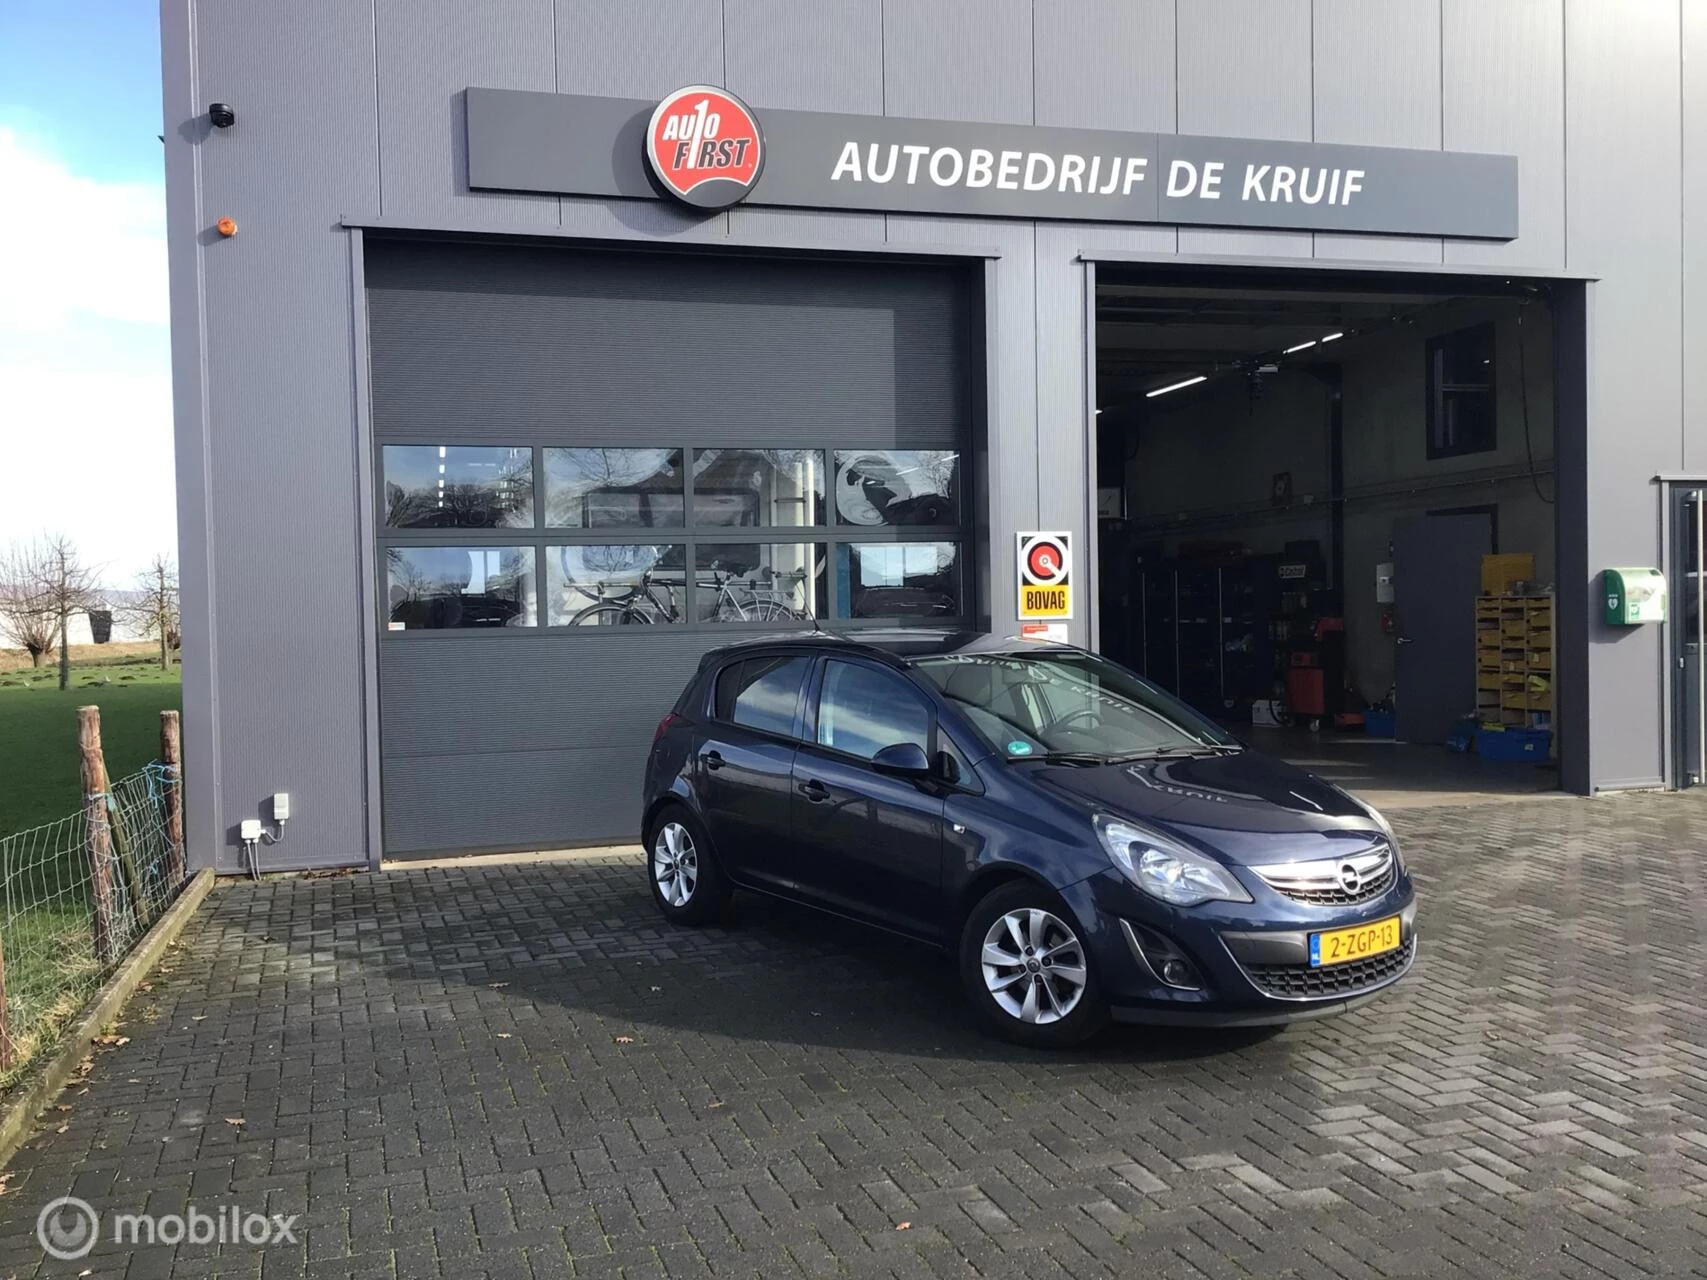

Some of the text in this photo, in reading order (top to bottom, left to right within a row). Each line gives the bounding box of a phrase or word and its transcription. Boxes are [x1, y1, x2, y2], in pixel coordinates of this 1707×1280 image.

[673, 138, 752, 170] FIRST
[831, 141, 1365, 206] AUTOBEDRIJF DE KRUIF
[1027, 590, 1065, 610] BOVAG
[1330, 925, 1393, 958] 2-ZGP-13
